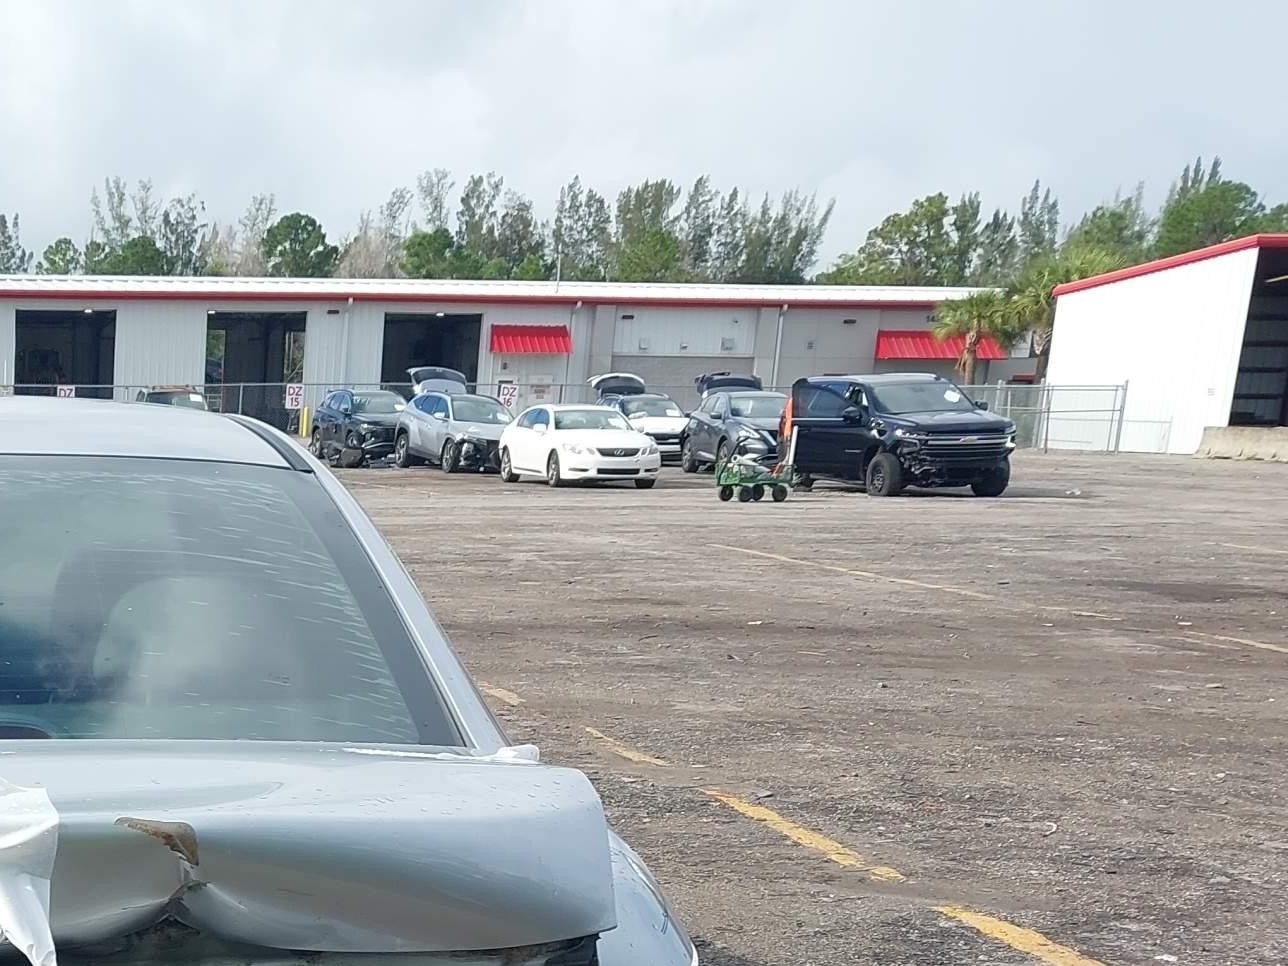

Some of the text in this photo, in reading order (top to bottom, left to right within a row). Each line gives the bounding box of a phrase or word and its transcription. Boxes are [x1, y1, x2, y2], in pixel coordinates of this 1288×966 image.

[287, 386, 303, 396] DZ
[502, 386, 517, 397] DZ
[290, 396, 300, 407] 15
[503, 397, 512, 407] 16
